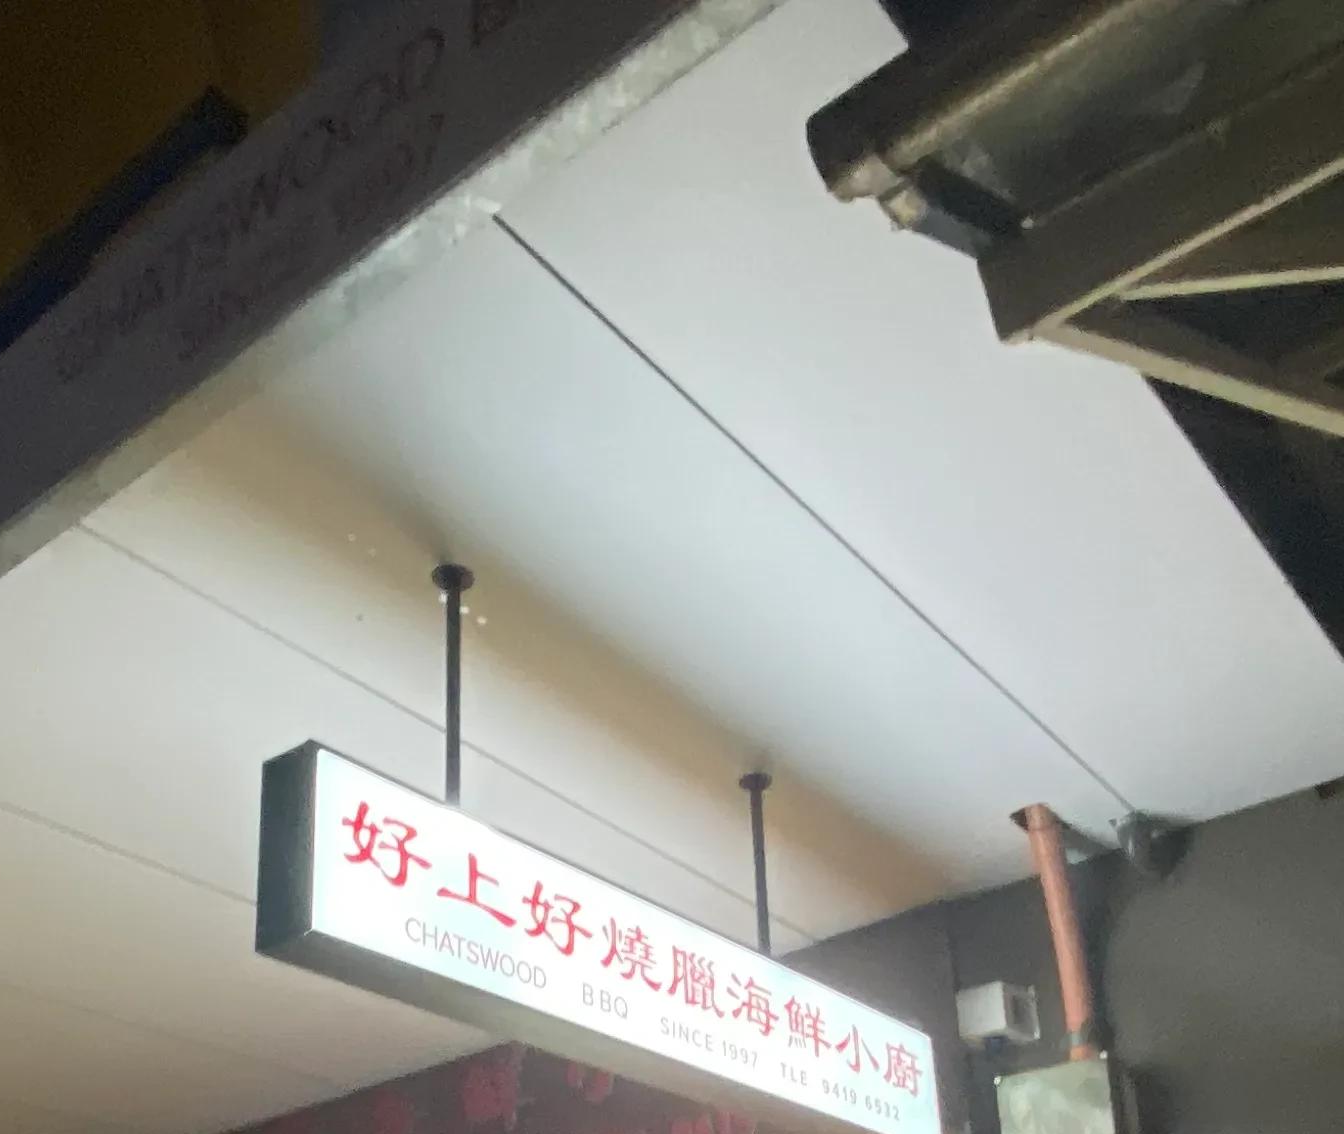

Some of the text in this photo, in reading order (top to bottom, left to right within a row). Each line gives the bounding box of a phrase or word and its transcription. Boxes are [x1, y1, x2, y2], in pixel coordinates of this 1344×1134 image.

[405, 917, 548, 990] CHATSWOOD
[581, 981, 629, 1020] BBQ
[659, 1016, 714, 1052] SINCE
[722, 1039, 758, 1068] 1997
[779, 1062, 809, 1086] TLE
[821, 1079, 858, 1104] 9419
